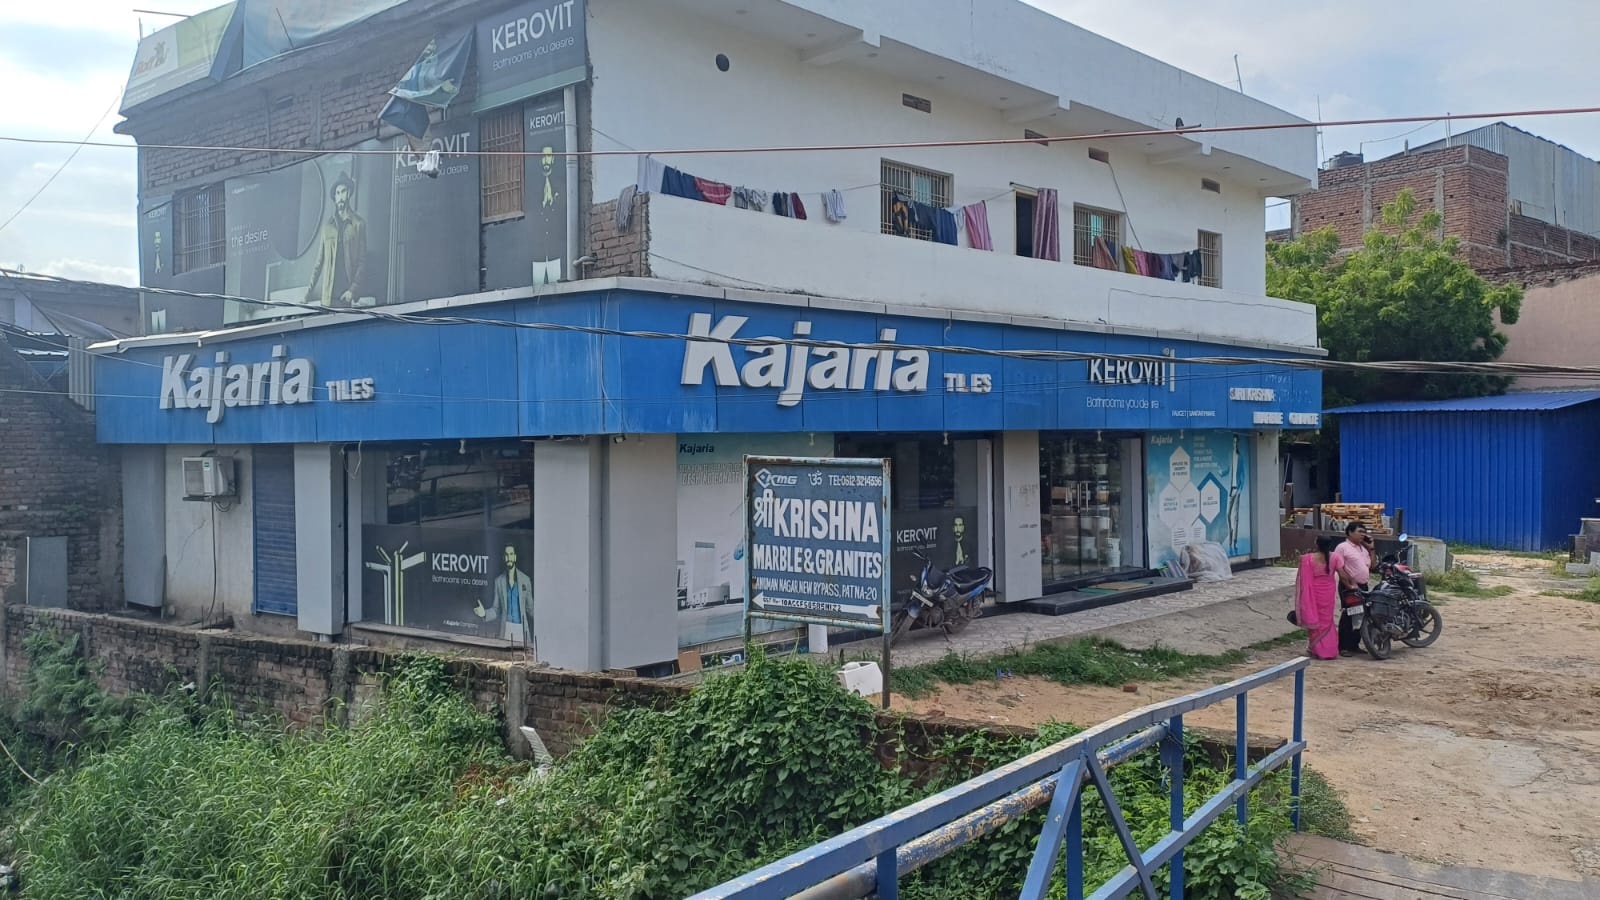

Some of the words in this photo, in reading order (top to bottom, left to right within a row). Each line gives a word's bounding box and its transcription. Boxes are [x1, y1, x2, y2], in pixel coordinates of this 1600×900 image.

[491, 0, 575, 54] KEROVIT
[493, 48, 533, 71] Bathrooms
[533, 44, 549, 61] you
[549, 36, 575, 52] desire
[529, 111, 565, 129] KEROVIT
[231, 234, 244, 248] the
[244, 229, 269, 247] desire
[680, 312, 930, 408] Kajaria
[943, 372, 992, 394] TILES
[159, 344, 316, 424] Kajaria
[325, 377, 375, 402] TILES
[679, 443, 715, 455] Kajaria
[773, 497, 880, 543] KRISHNA
[432, 552, 489, 574] KEROVIT
[432, 575, 460, 584] Bathrooms
[461, 577, 471, 585] you
[472, 577, 488, 586] desire
